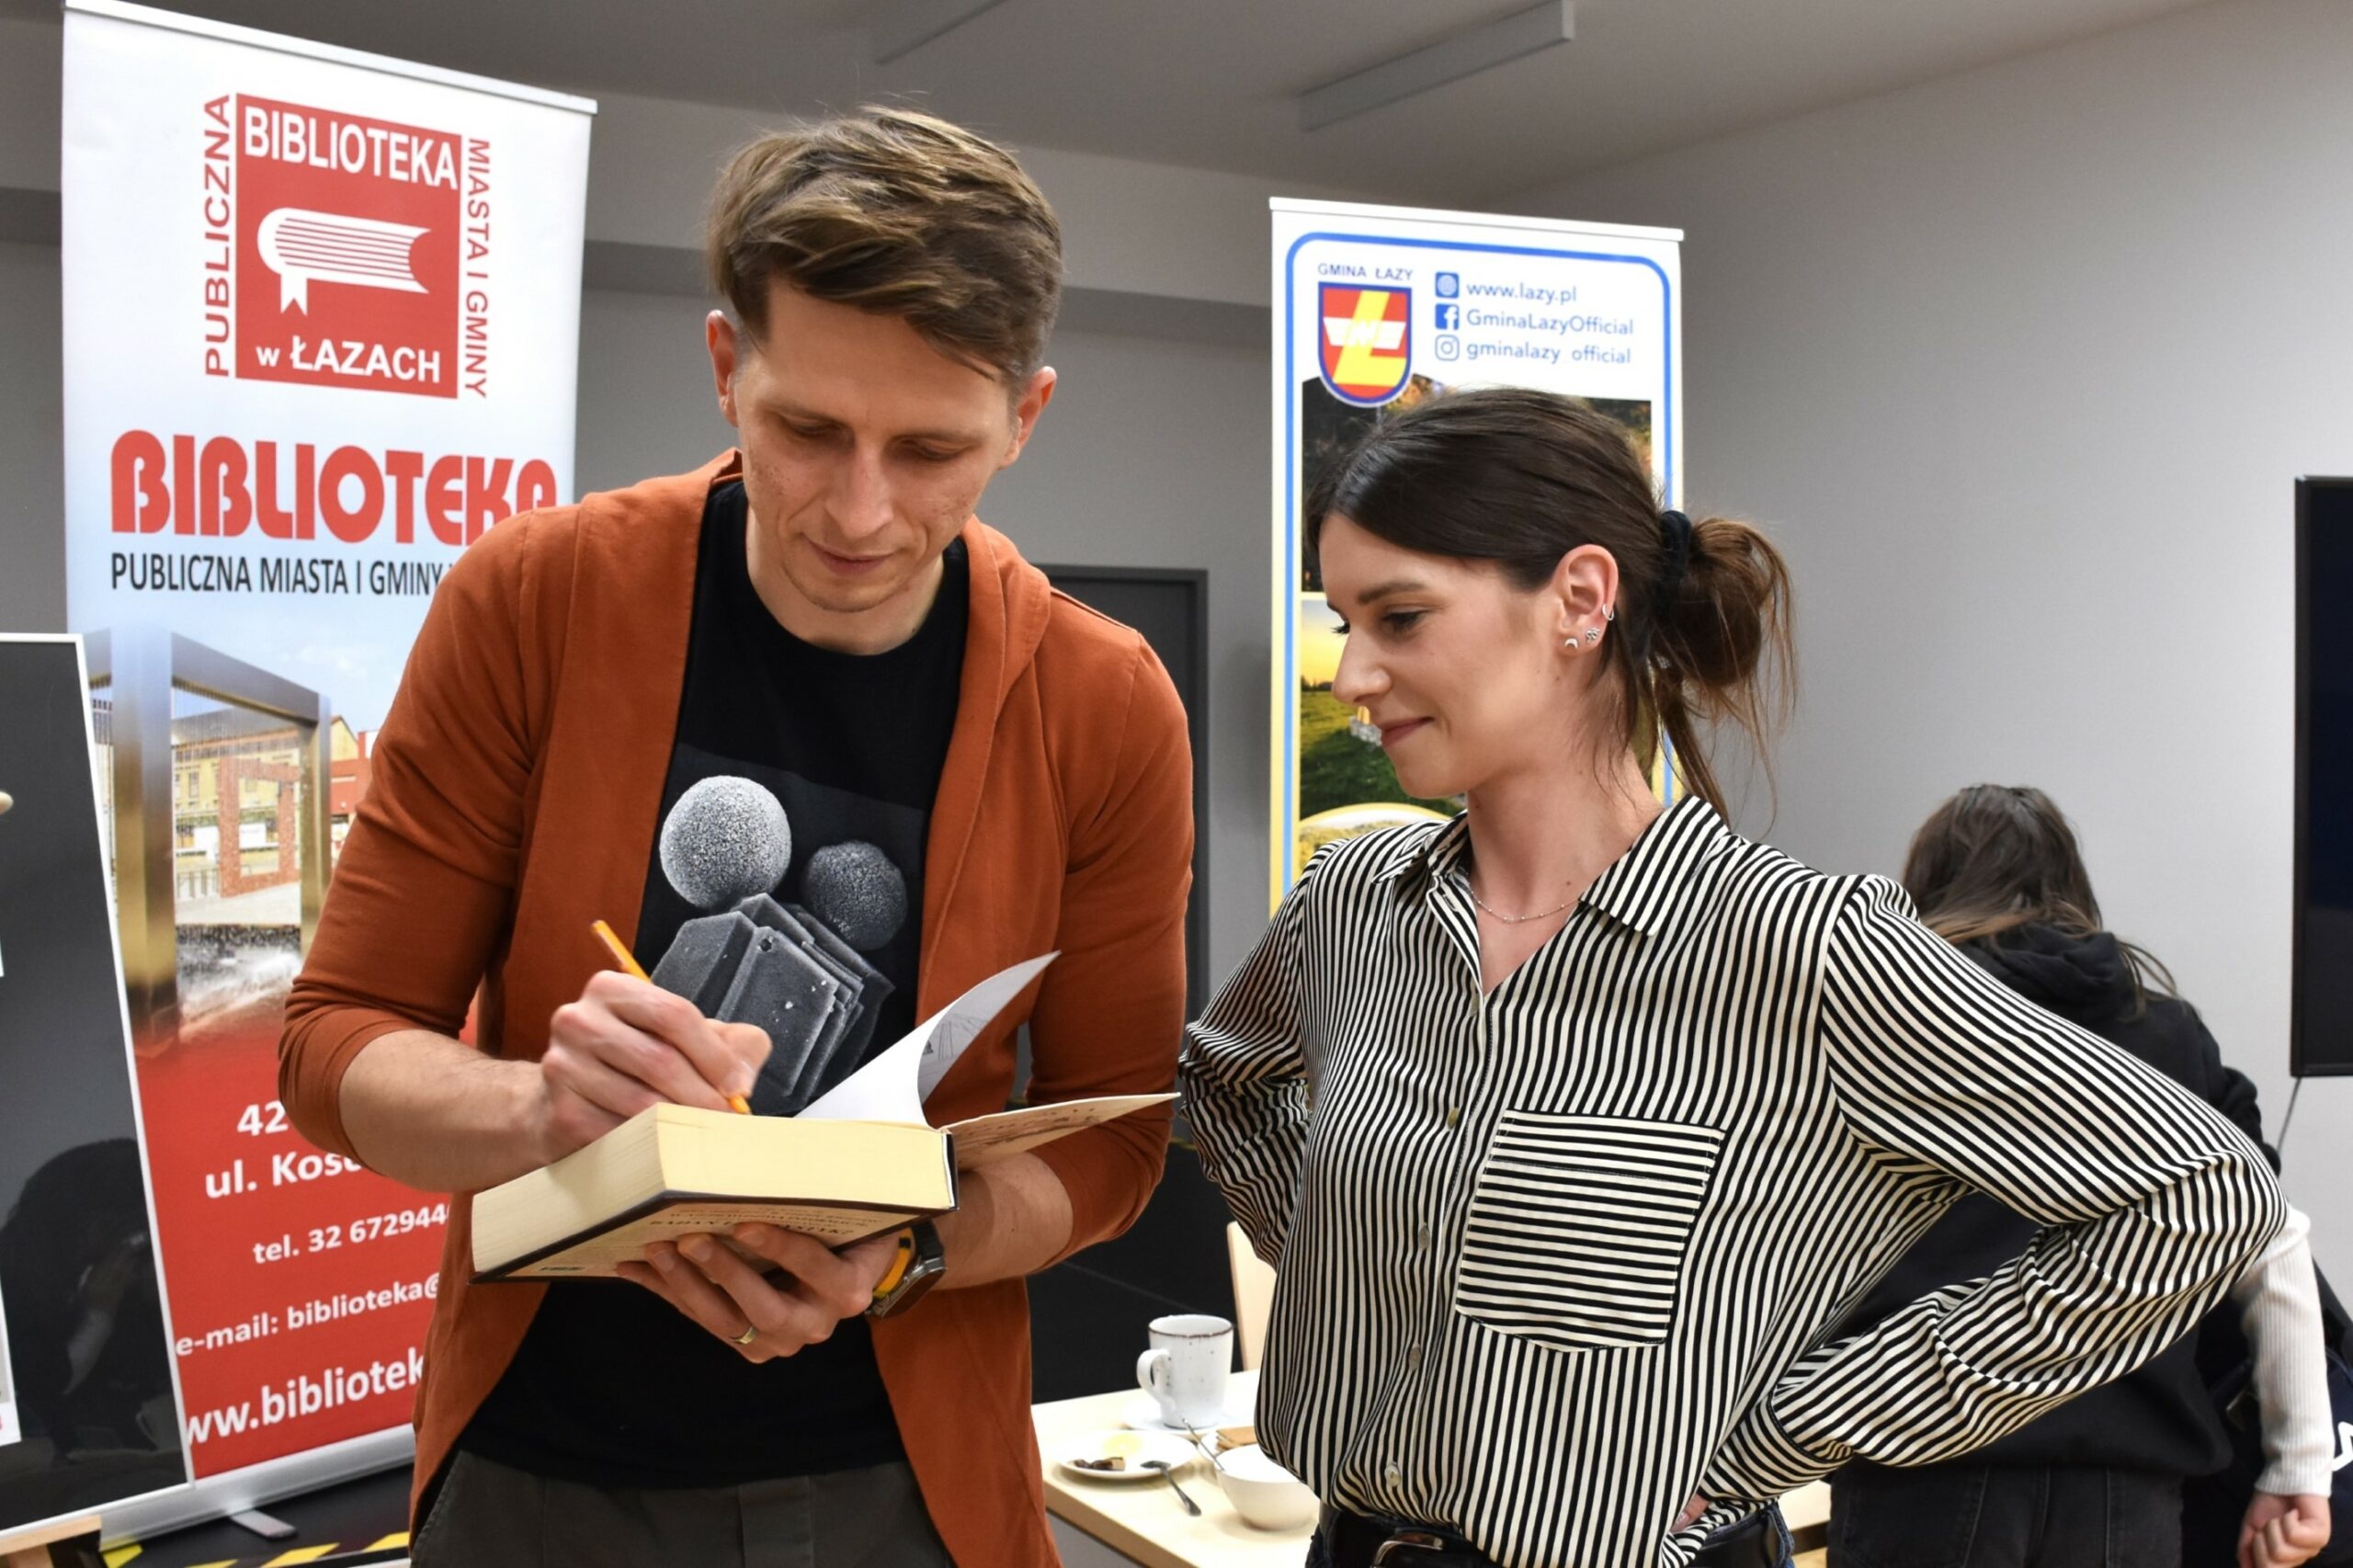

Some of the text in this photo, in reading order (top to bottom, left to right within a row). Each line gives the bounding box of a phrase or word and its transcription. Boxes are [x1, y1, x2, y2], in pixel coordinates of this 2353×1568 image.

[244, 105, 458, 190] BIBLIOTEKA
[204, 94, 230, 378] PUBLICZNA
[464, 137, 491, 399] MIASTA I GMINY
[1317, 262, 1368, 278] GMINA
[1466, 281, 1578, 306] www.lazy.pl
[1466, 308, 1634, 336] GminaLazyOfficial
[290, 334, 441, 384] ŁAZACH
[110, 428, 558, 547] BIBLIOTEKA
[111, 551, 443, 597] PUBLICZNA MIASTA I GMINY
[236, 1099, 289, 1137] 42
[205, 1158, 258, 1199] ul.
[253, 1202, 449, 1265] tel. 32 672944
[175, 1312, 279, 1358] e-mail:
